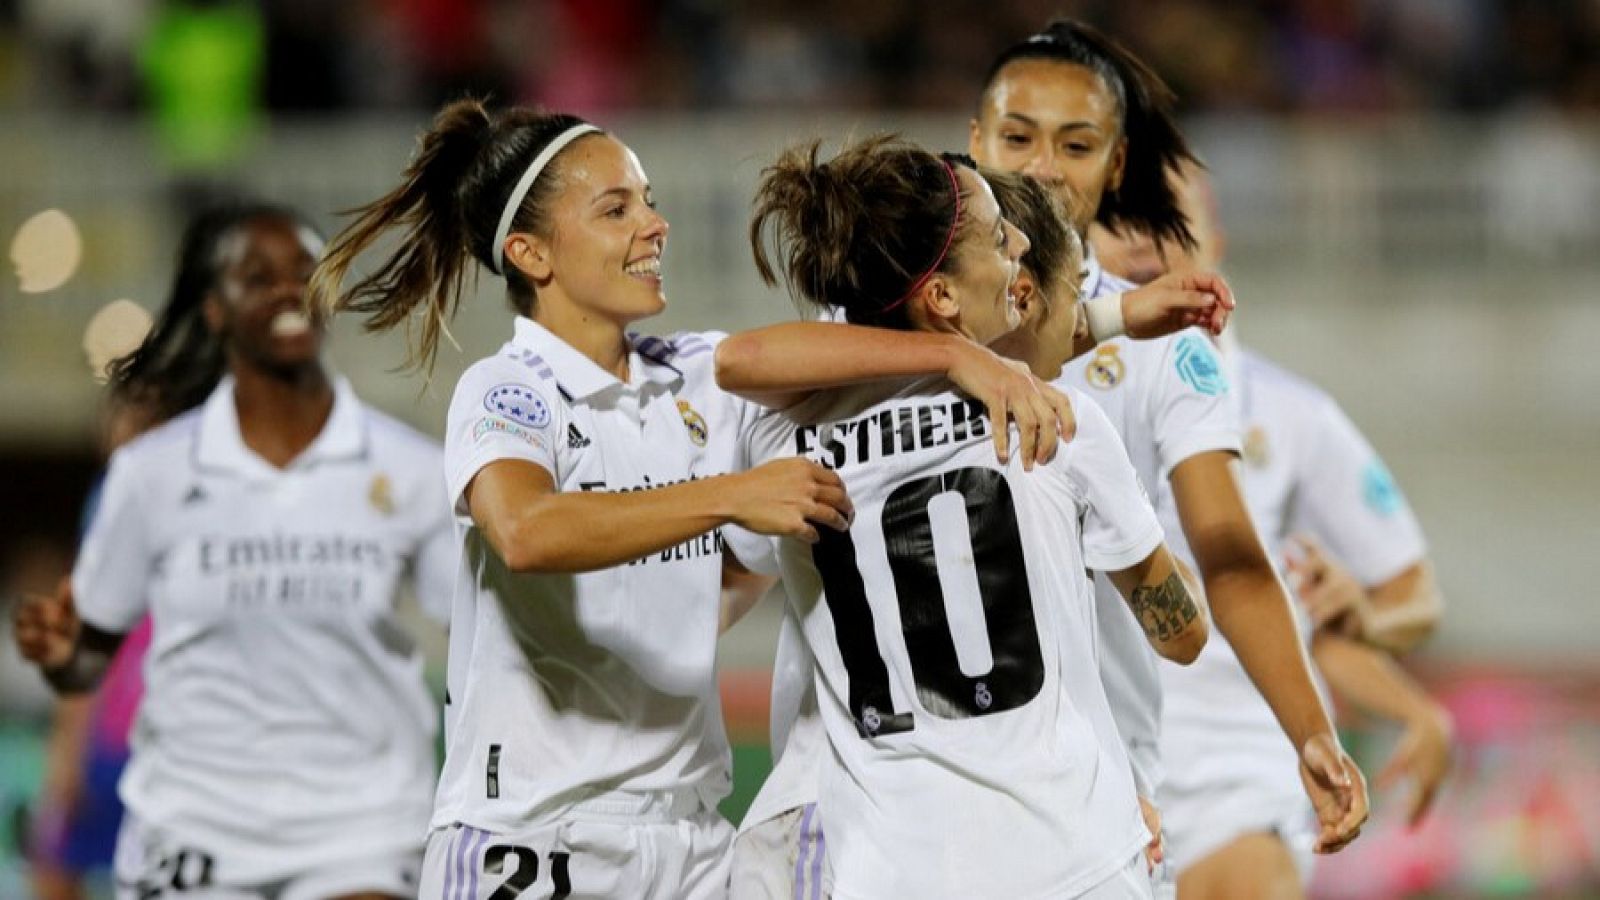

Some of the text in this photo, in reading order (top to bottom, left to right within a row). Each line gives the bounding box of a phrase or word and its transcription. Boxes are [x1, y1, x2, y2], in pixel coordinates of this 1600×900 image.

[796, 401, 985, 469] ESTHER
[811, 466, 1044, 738] 10
[483, 844, 571, 900] 21
